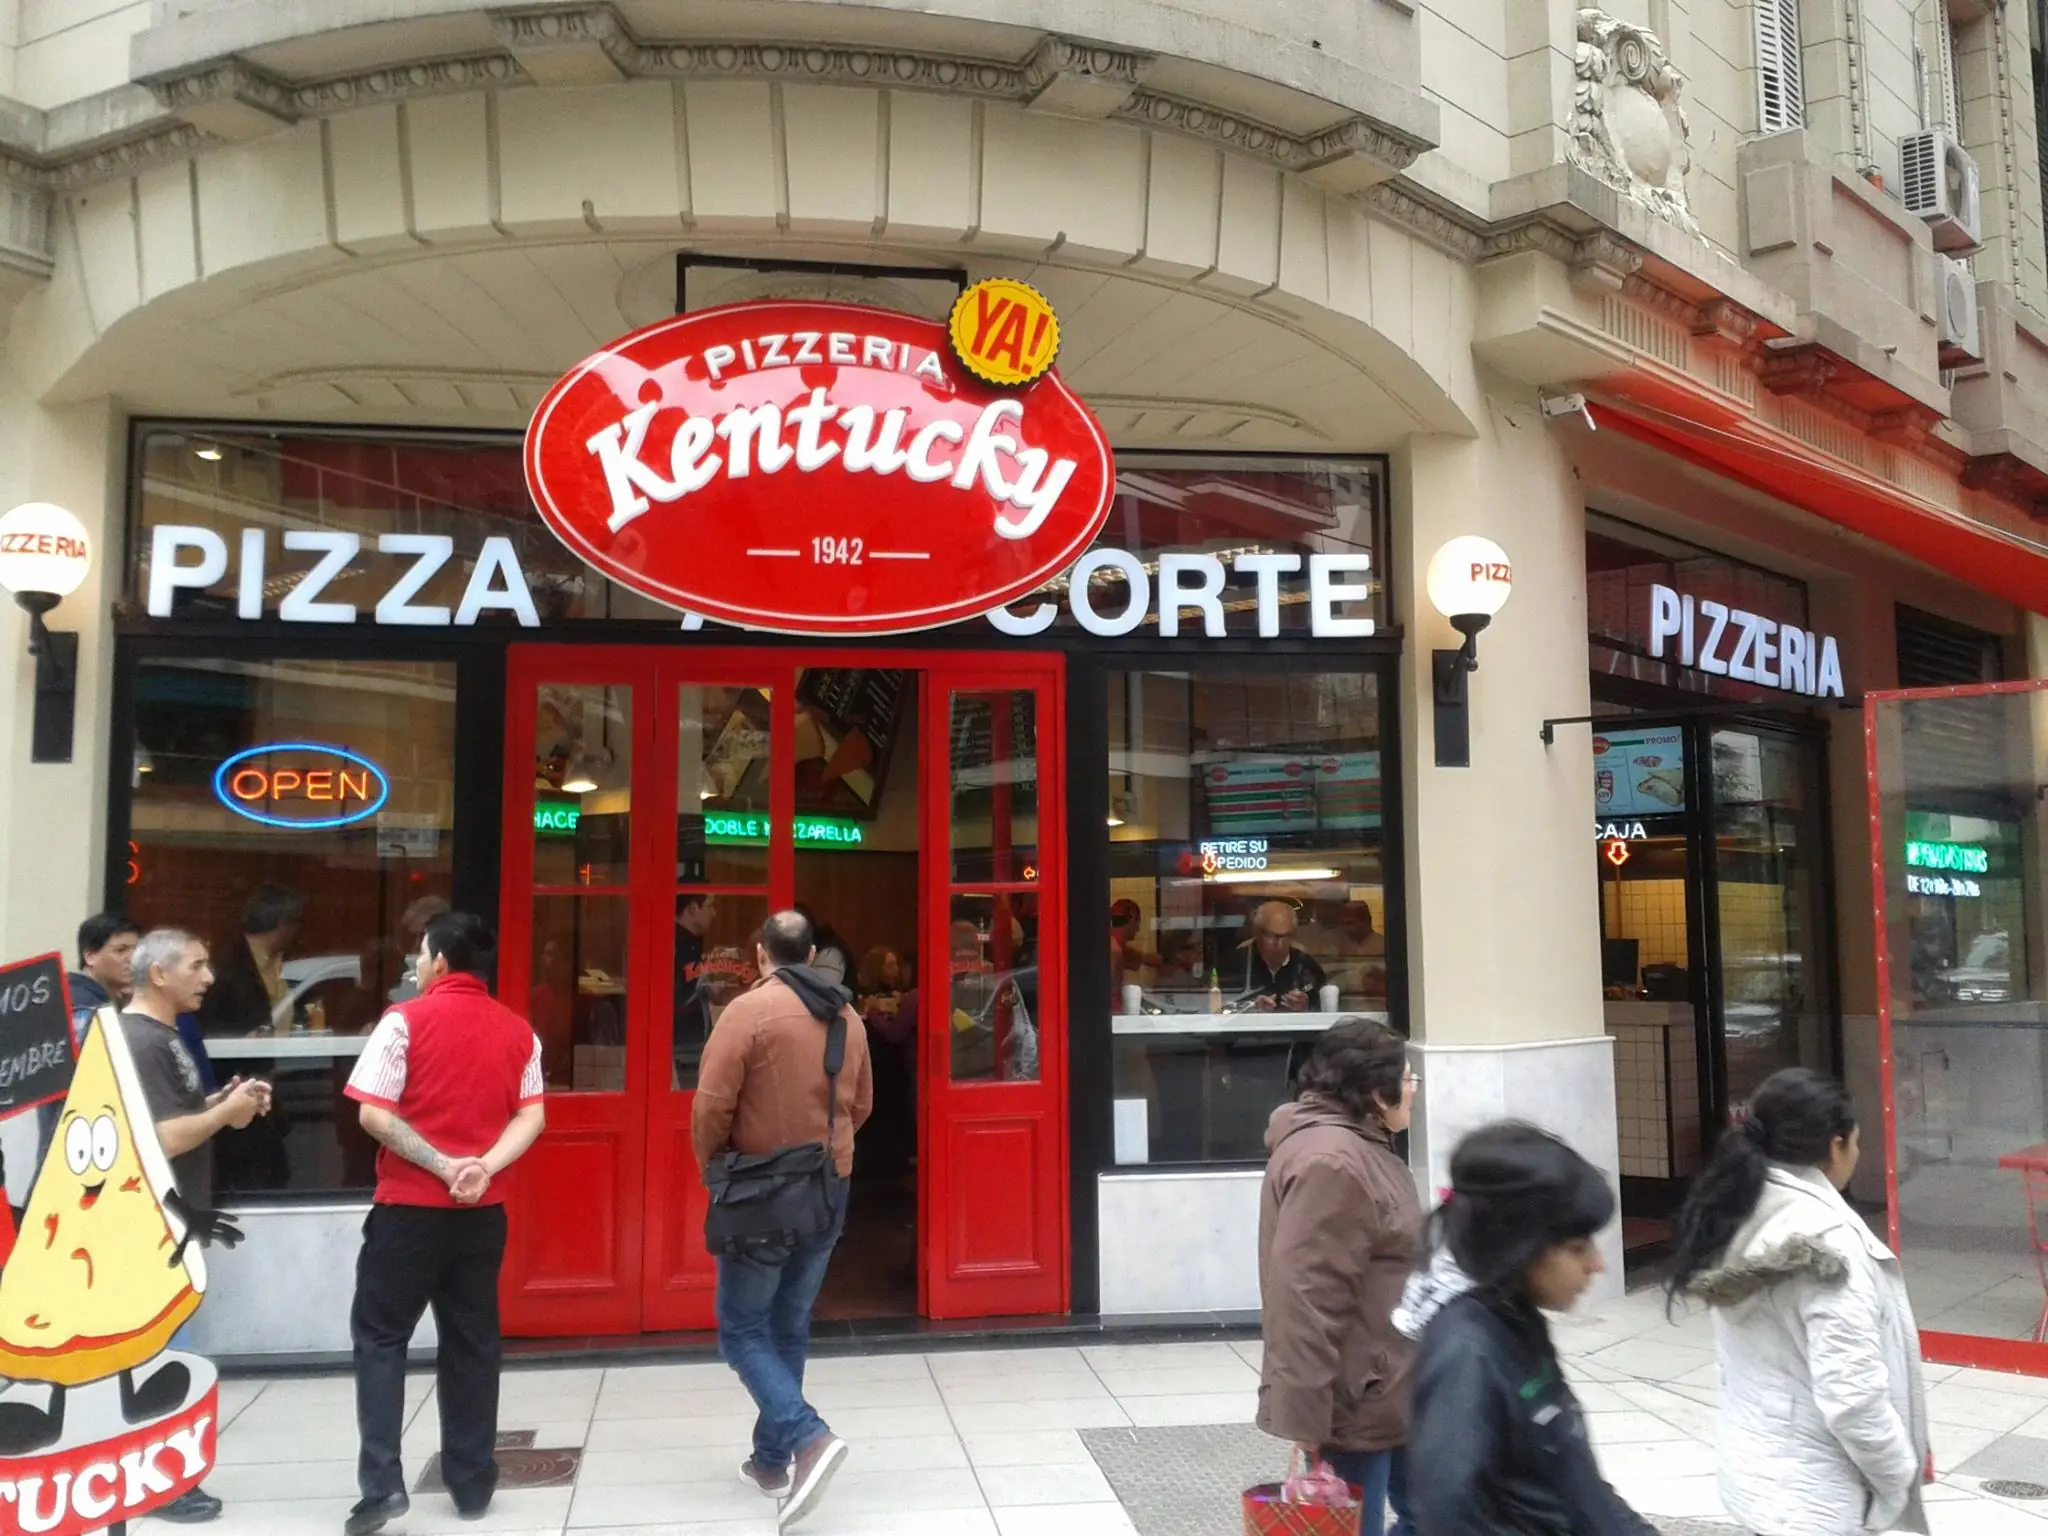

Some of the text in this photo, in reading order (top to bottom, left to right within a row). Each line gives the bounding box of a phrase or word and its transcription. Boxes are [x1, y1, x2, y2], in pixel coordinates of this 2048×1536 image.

[969, 287, 1047, 375] YA!
[702, 330, 948, 386] PIZZERIA
[586, 386, 1078, 541] Kentucky
[811, 536, 864, 567] 1942
[147, 524, 541, 627] PIZZA
[1470, 562, 1513, 586] PIZZ
[1651, 583, 1845, 698] PIZZERIA
[233, 769, 369, 801] OPEN
[704, 817, 863, 843] DOBLE ZARELLA
[1200, 839, 1268, 855] RETIRE SU
[1217, 856, 1267, 870] PEDIDO
